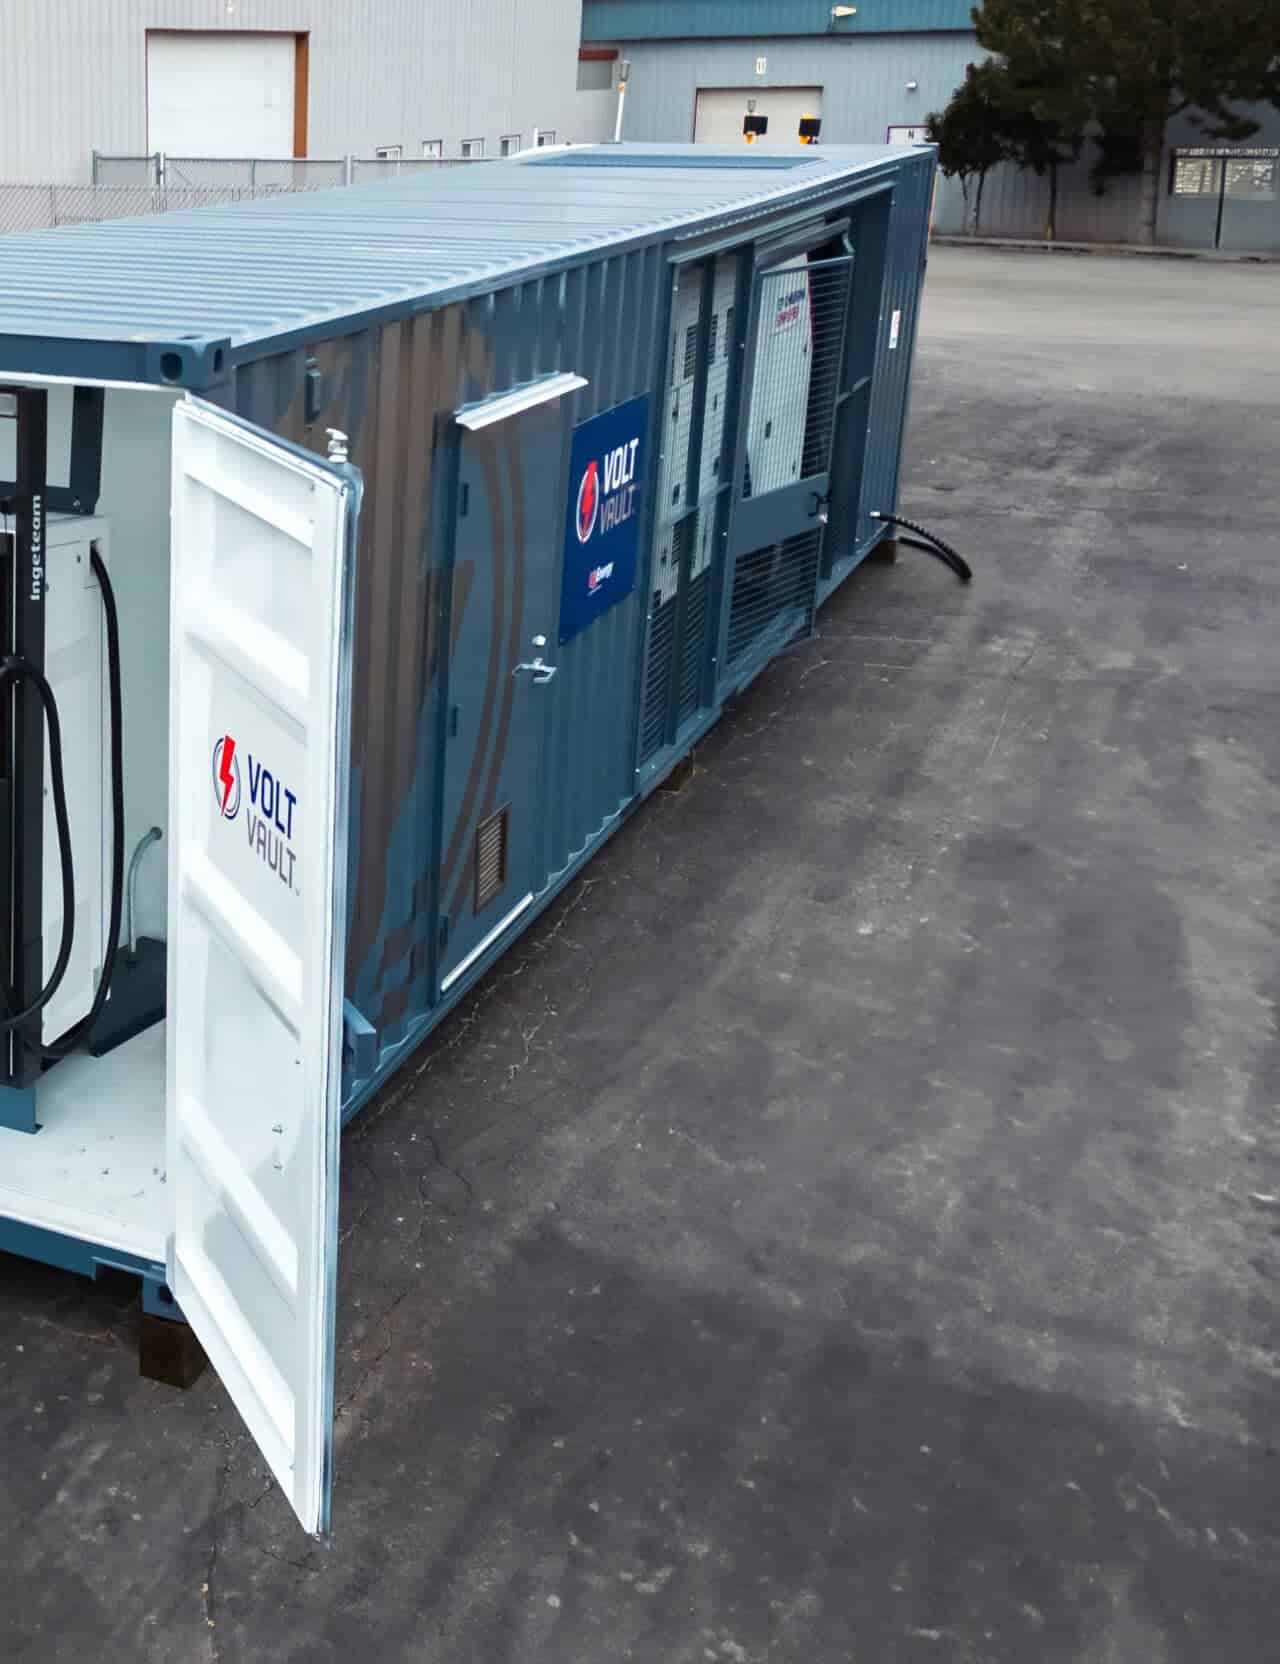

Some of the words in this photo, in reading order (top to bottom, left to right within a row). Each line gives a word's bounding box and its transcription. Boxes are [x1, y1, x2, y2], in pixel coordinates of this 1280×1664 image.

[603, 437, 640, 494] VOLT
[30, 495, 44, 600] Ingeteam
[600, 484, 636, 533] VAULT
[247, 754, 297, 840] VOLT
[246, 808, 297, 889] VAULT
